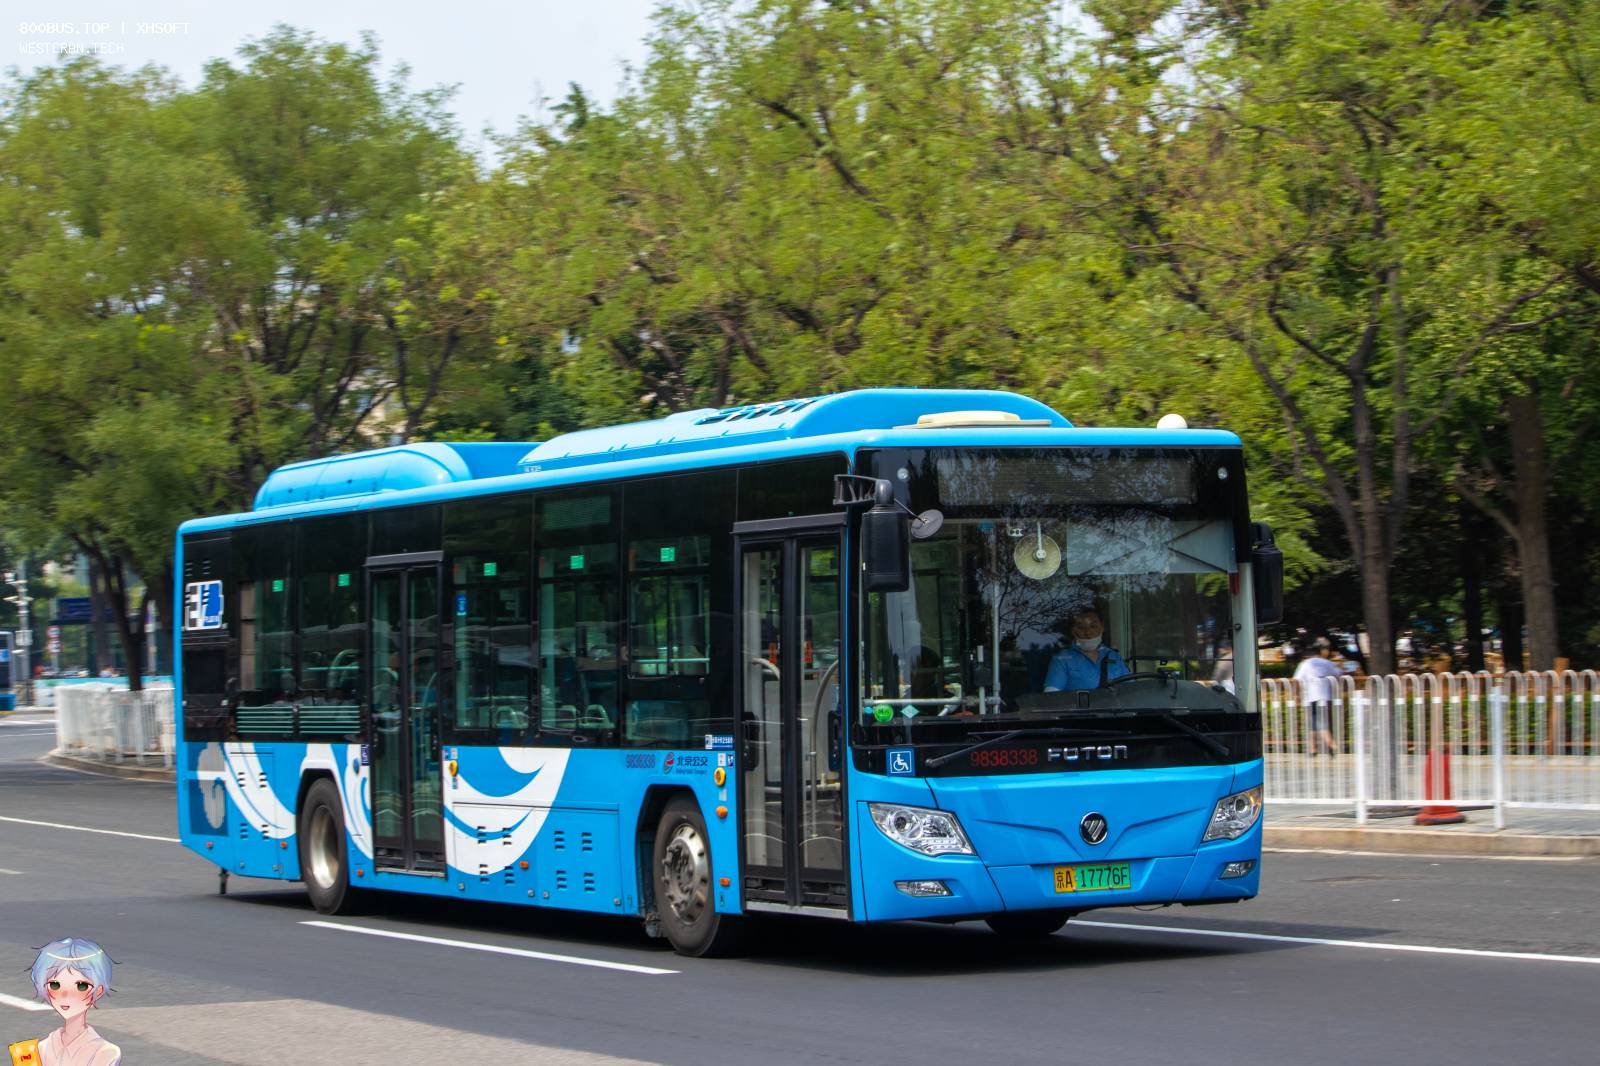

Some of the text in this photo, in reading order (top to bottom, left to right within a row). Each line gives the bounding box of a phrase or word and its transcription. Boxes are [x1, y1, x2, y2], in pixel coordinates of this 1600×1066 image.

[676, 755, 708, 767] 北京公交
[970, 749, 1038, 767] 9838338
[1048, 745, 1128, 762] FOTON
